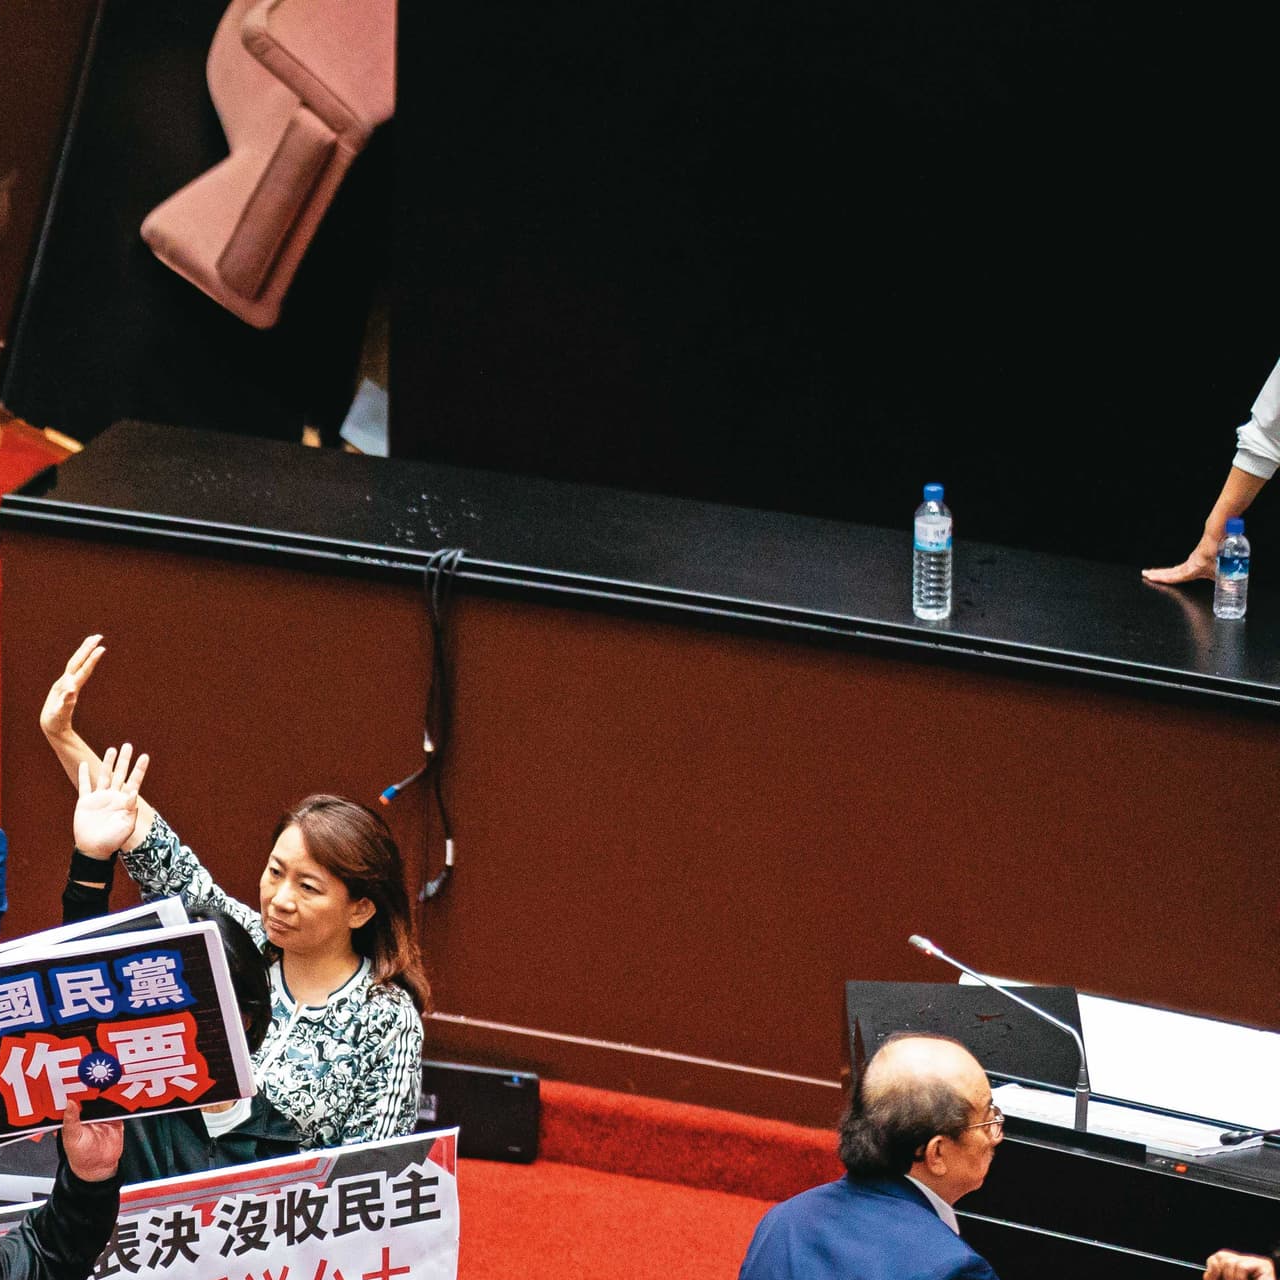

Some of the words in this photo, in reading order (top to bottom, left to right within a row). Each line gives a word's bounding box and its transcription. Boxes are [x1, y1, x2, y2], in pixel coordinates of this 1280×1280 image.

[0, 1021, 199, 1117] 作票
[217, 1169, 442, 1259] 沒收民主
